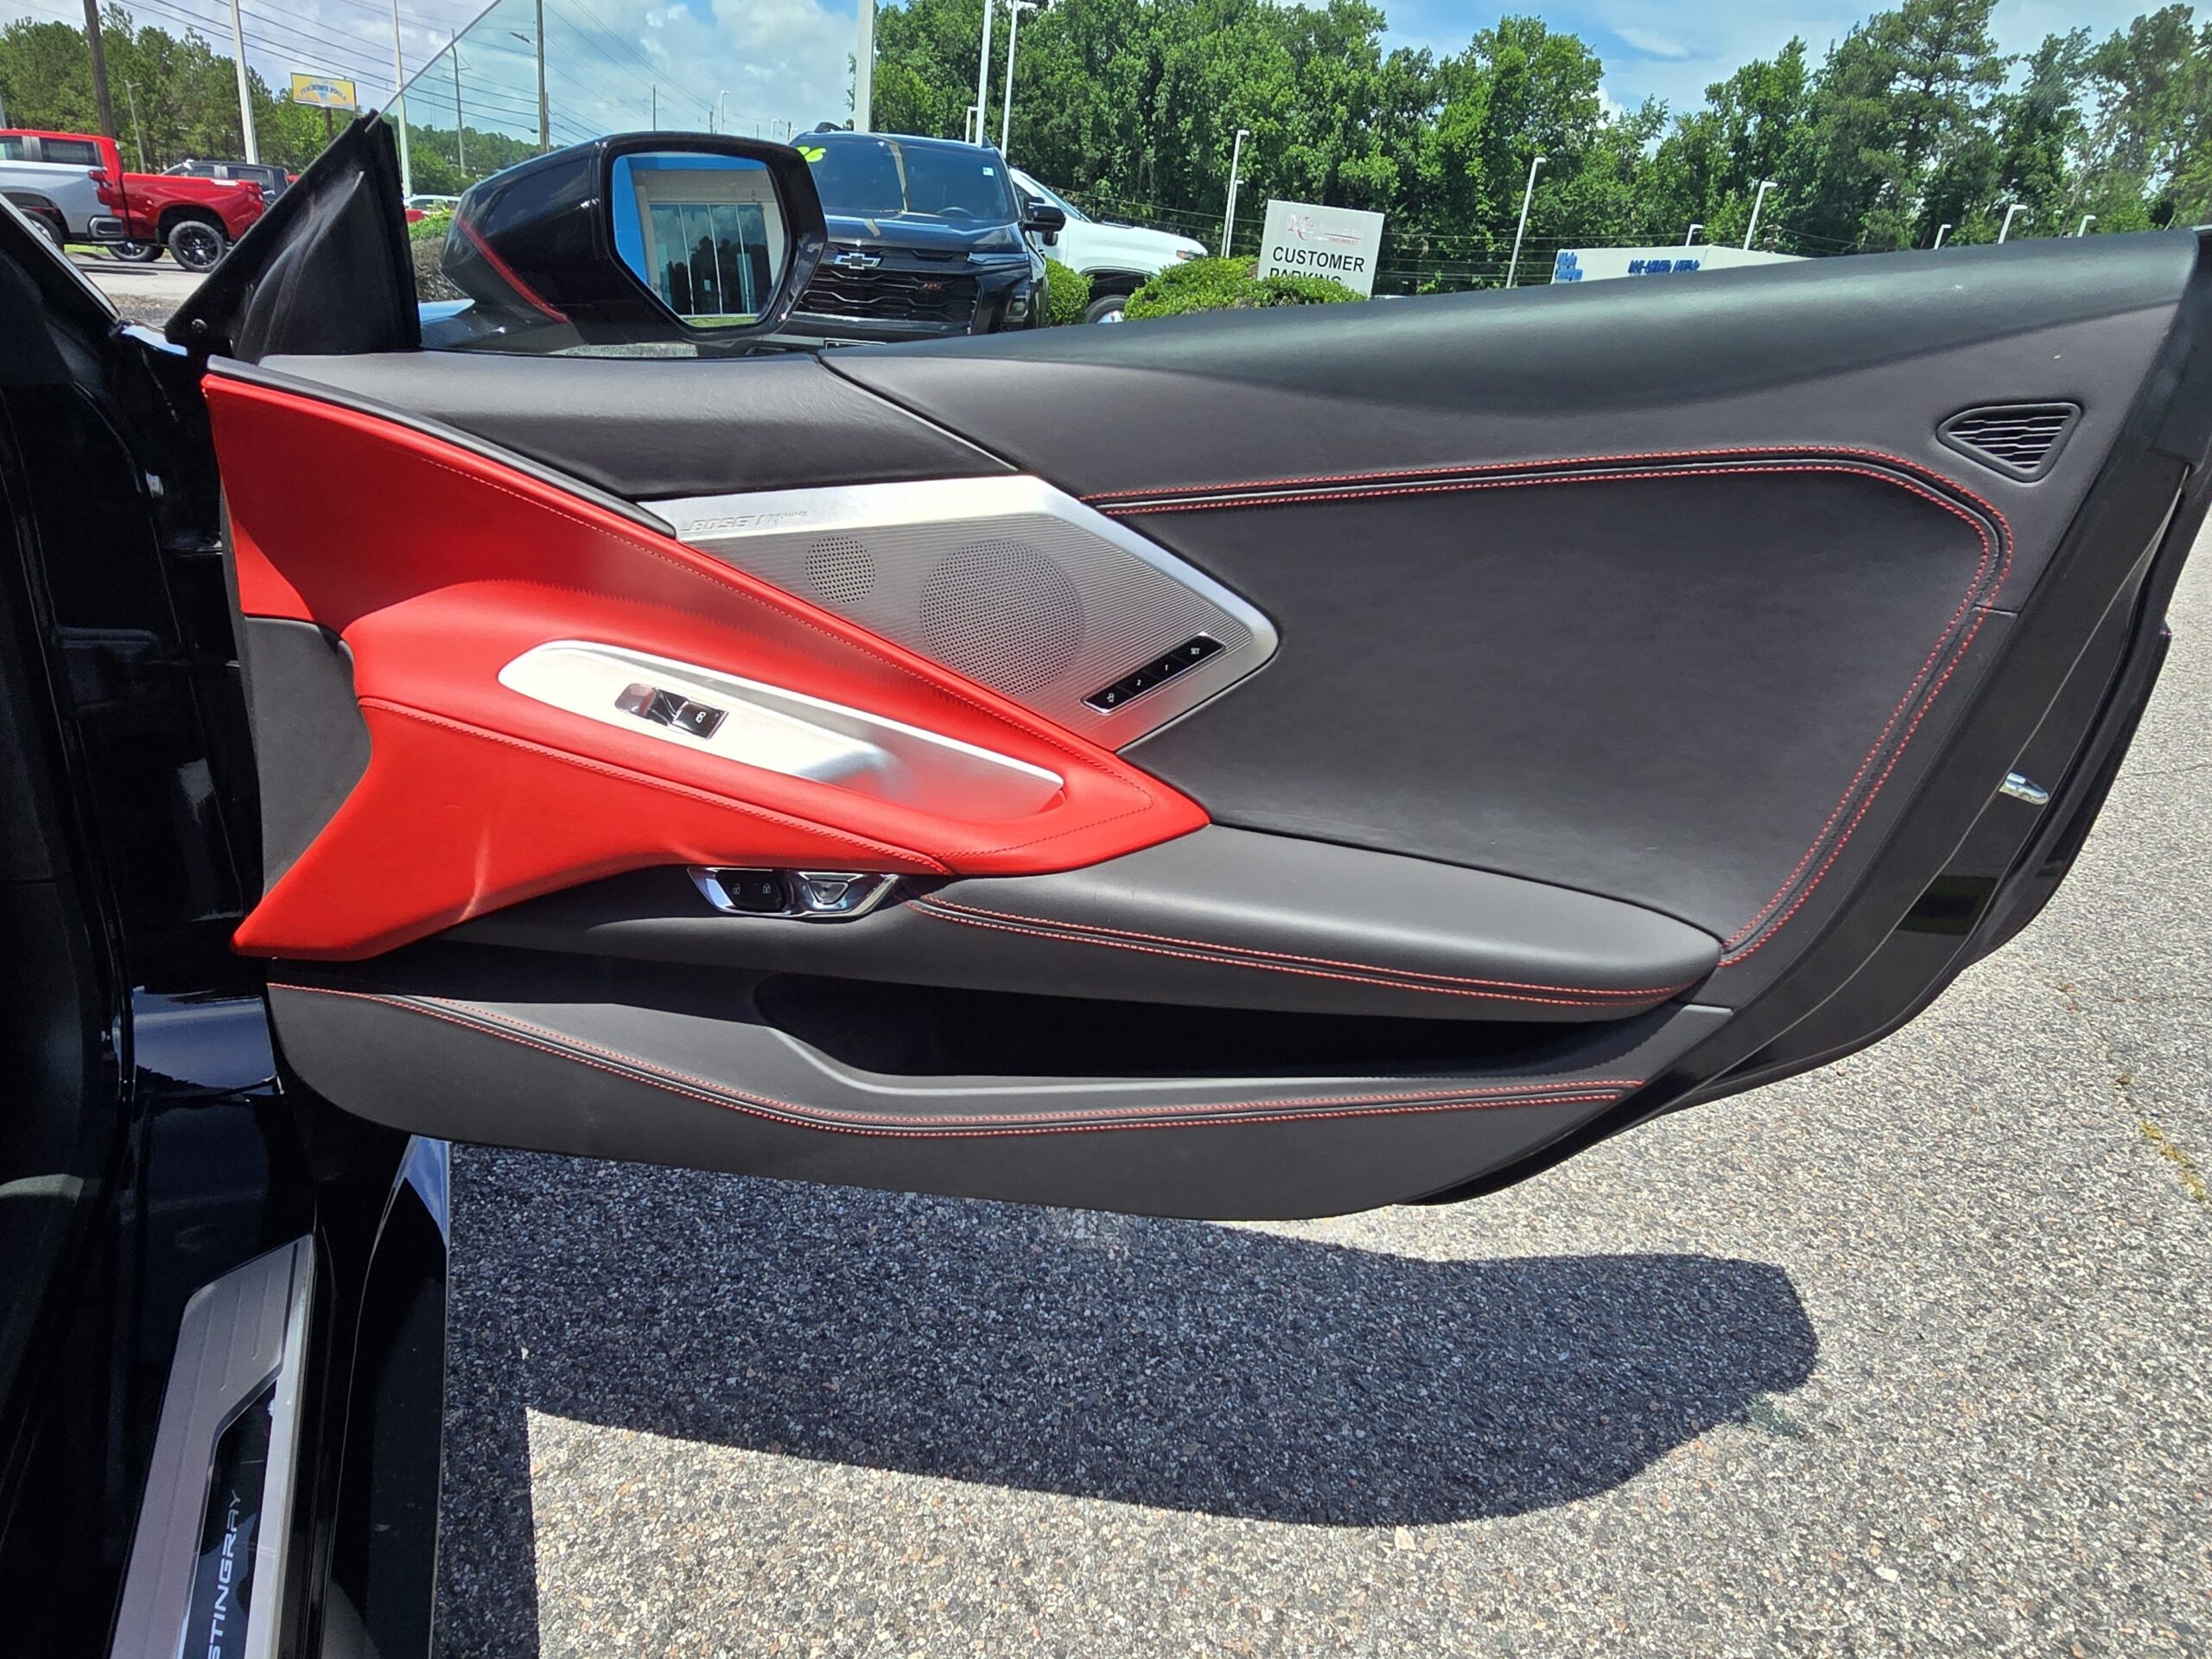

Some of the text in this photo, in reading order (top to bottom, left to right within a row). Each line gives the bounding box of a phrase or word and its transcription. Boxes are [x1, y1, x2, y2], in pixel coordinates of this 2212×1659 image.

[1272, 246, 1365, 273] CUSTOMER
[686, 515, 755, 532] BOSE
[207, 1489, 241, 1659] STINGRAY
